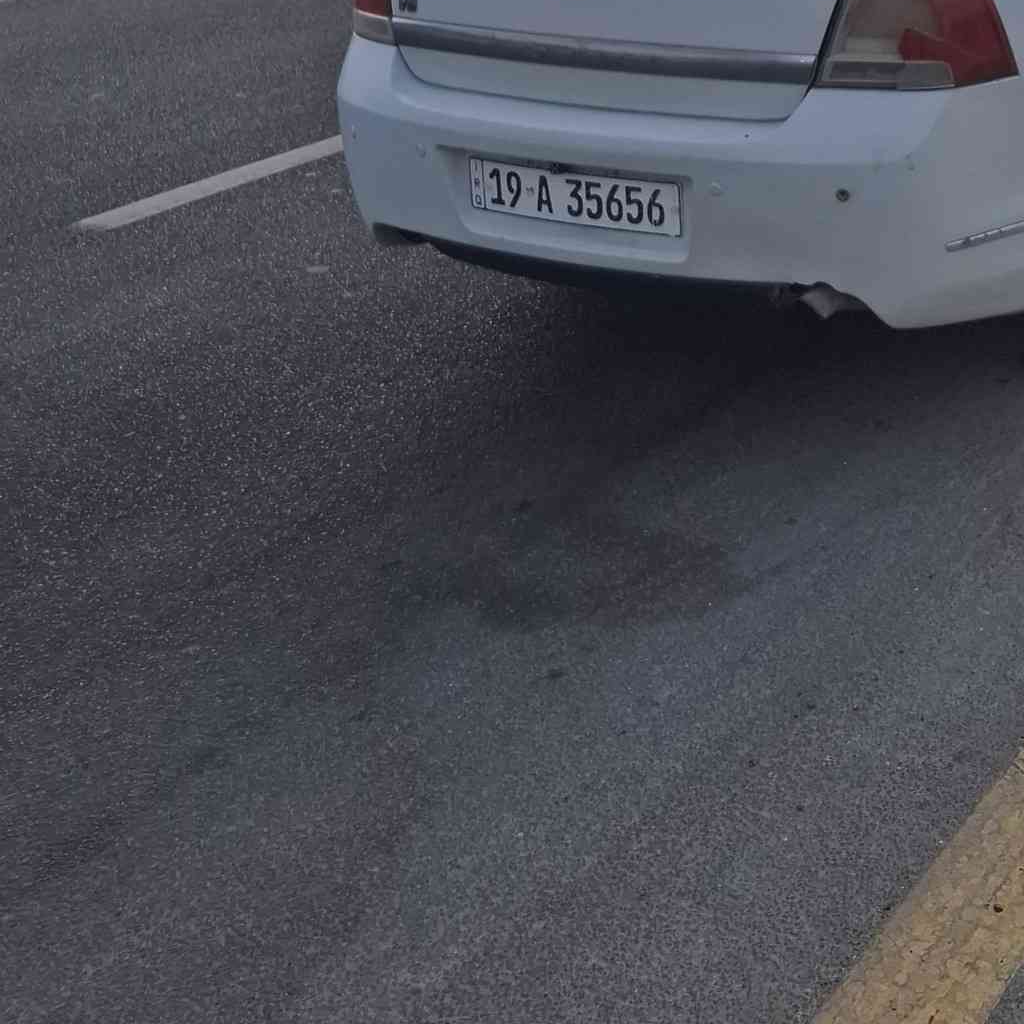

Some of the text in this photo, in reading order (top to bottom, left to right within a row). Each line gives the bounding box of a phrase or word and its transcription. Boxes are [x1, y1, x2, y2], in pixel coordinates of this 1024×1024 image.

[489, 167, 665, 227] 19 A 35656
